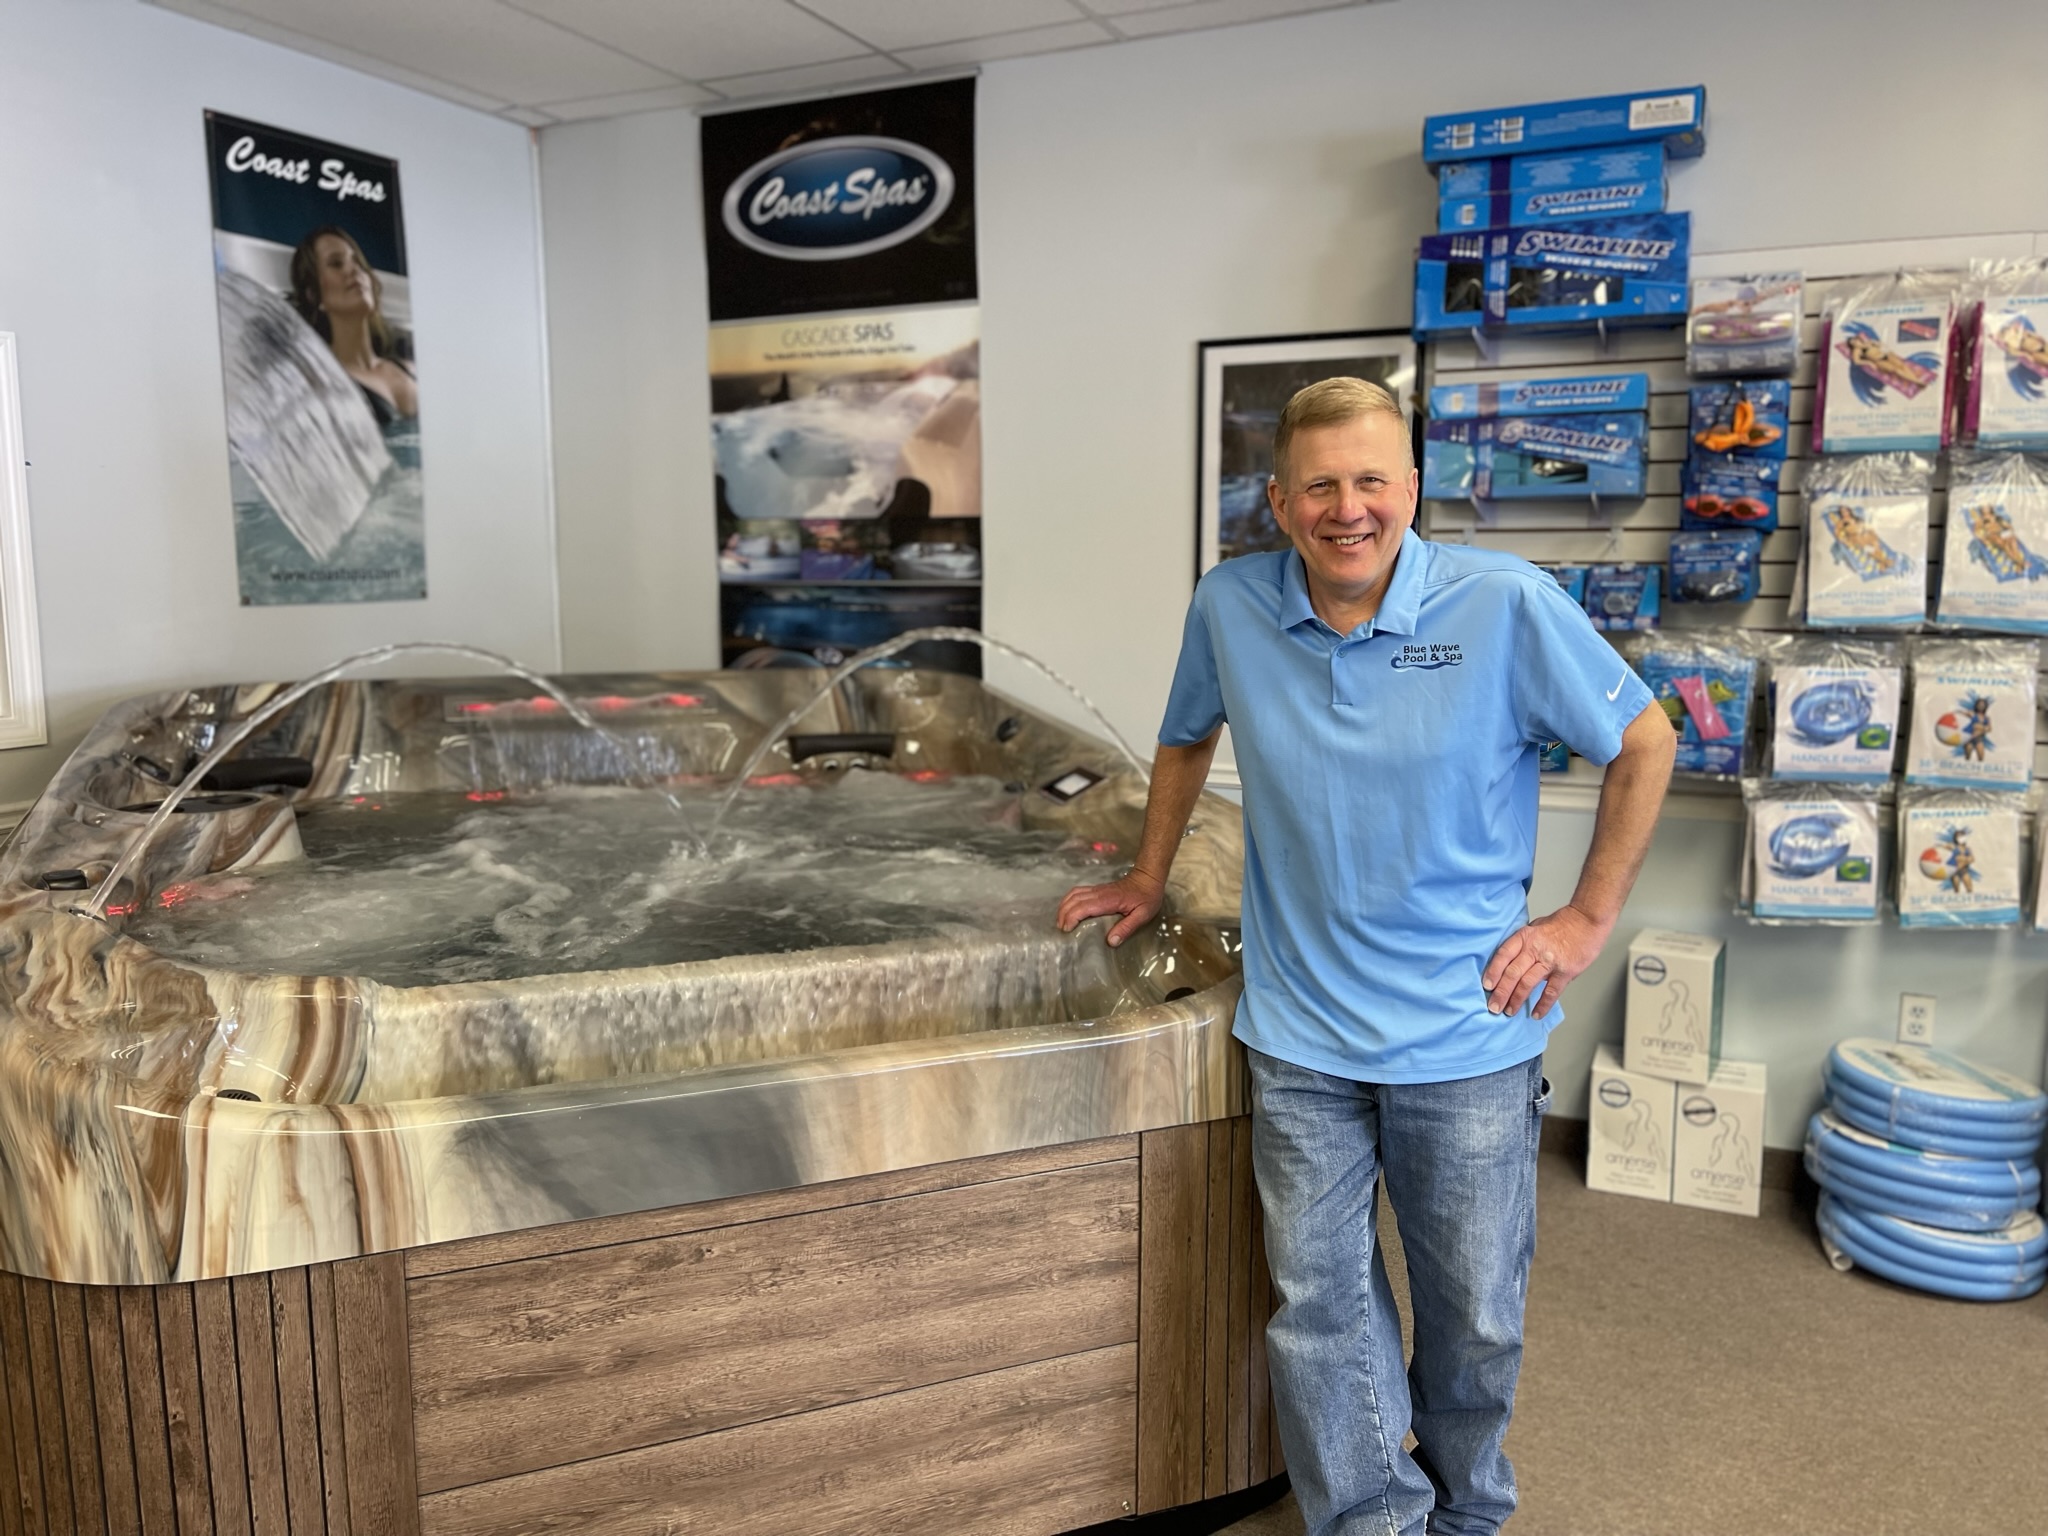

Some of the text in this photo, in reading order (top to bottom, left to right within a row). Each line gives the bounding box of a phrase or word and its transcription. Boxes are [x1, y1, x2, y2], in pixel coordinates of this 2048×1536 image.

[225, 135, 386, 202] Coast Spas
[749, 167, 927, 225] Coast Spas
[1526, 184, 1646, 213] SWIMLINE
[1515, 230, 1677, 260] SWIMLINE
[1543, 253, 1592, 267] WATER
[781, 322, 894, 349] CASCADE SPAS
[1513, 378, 1631, 404] SWIMLINE
[1500, 420, 1633, 454] SWIMLINE
[1403, 644, 1460, 653] Blue Wave
[1403, 652, 1462, 662] Pool & Spa
[1791, 753, 1838, 764] HANDLE
